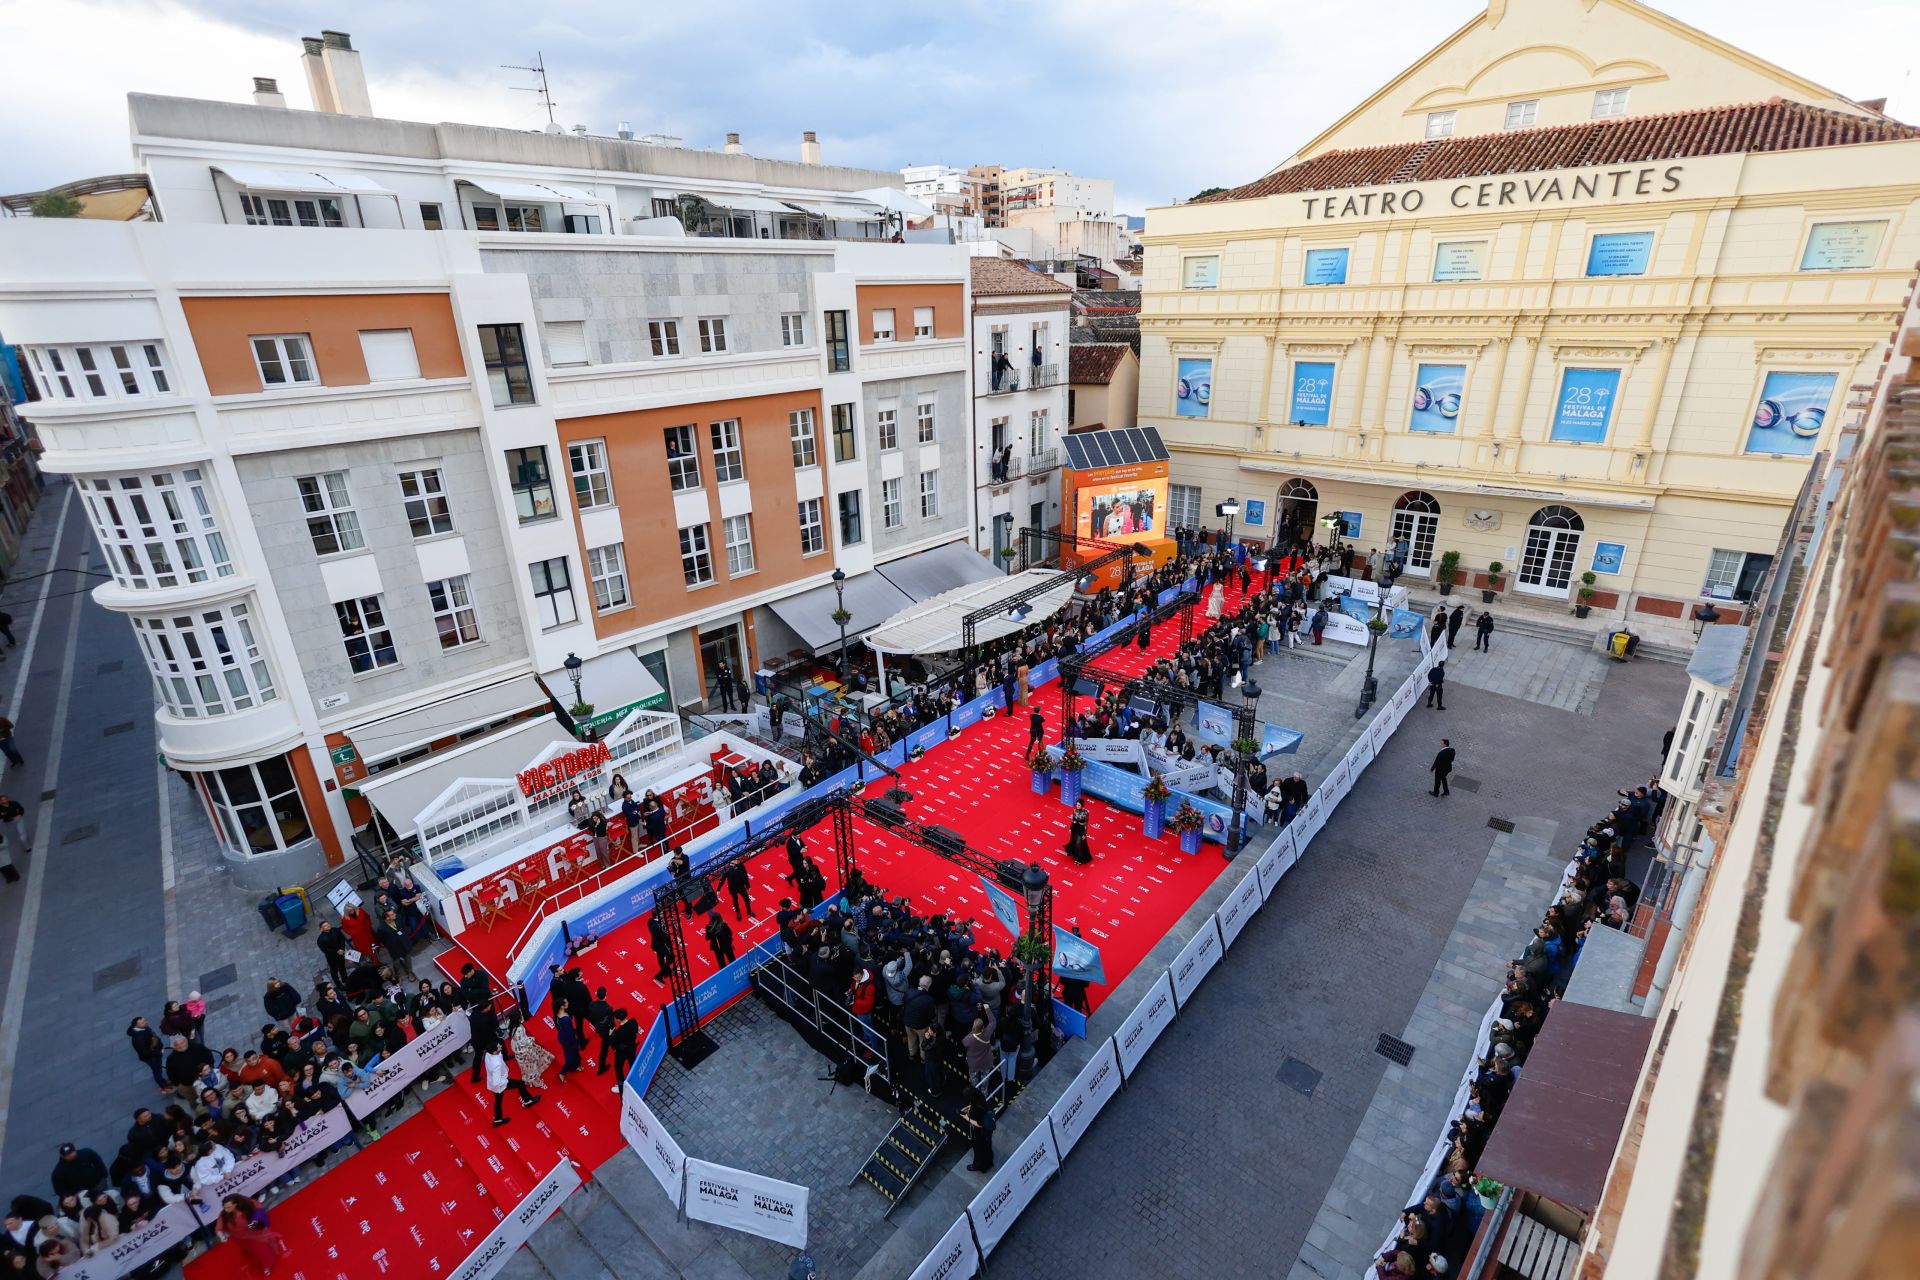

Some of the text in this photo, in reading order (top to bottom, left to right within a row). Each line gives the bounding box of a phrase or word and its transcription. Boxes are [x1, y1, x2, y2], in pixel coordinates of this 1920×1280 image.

[1302, 166, 1684, 220] TEATRO CERVANTES
[1298, 378, 1316, 392] 28
[1565, 387, 1592, 404] 28
[1110, 565, 1122, 578] 28
[516, 739, 612, 797] VICTORIA
[582, 768, 602, 781] 1928
[416, 1032, 444, 1054] FESTIVAL
[1020, 1150, 1039, 1173] FESTIVAL
[215, 1160, 264, 1192] FESTIVAL DE
[700, 1181, 729, 1193] FESTIVAL
[519, 1180, 557, 1220] FESTIVAL DE
[754, 1195, 783, 1207] FESTIVAL
[983, 1191, 1004, 1216] FESTIVAL
[111, 1219, 167, 1255] FESTIVAL DE
[461, 1246, 494, 1280] FESTIVAL
